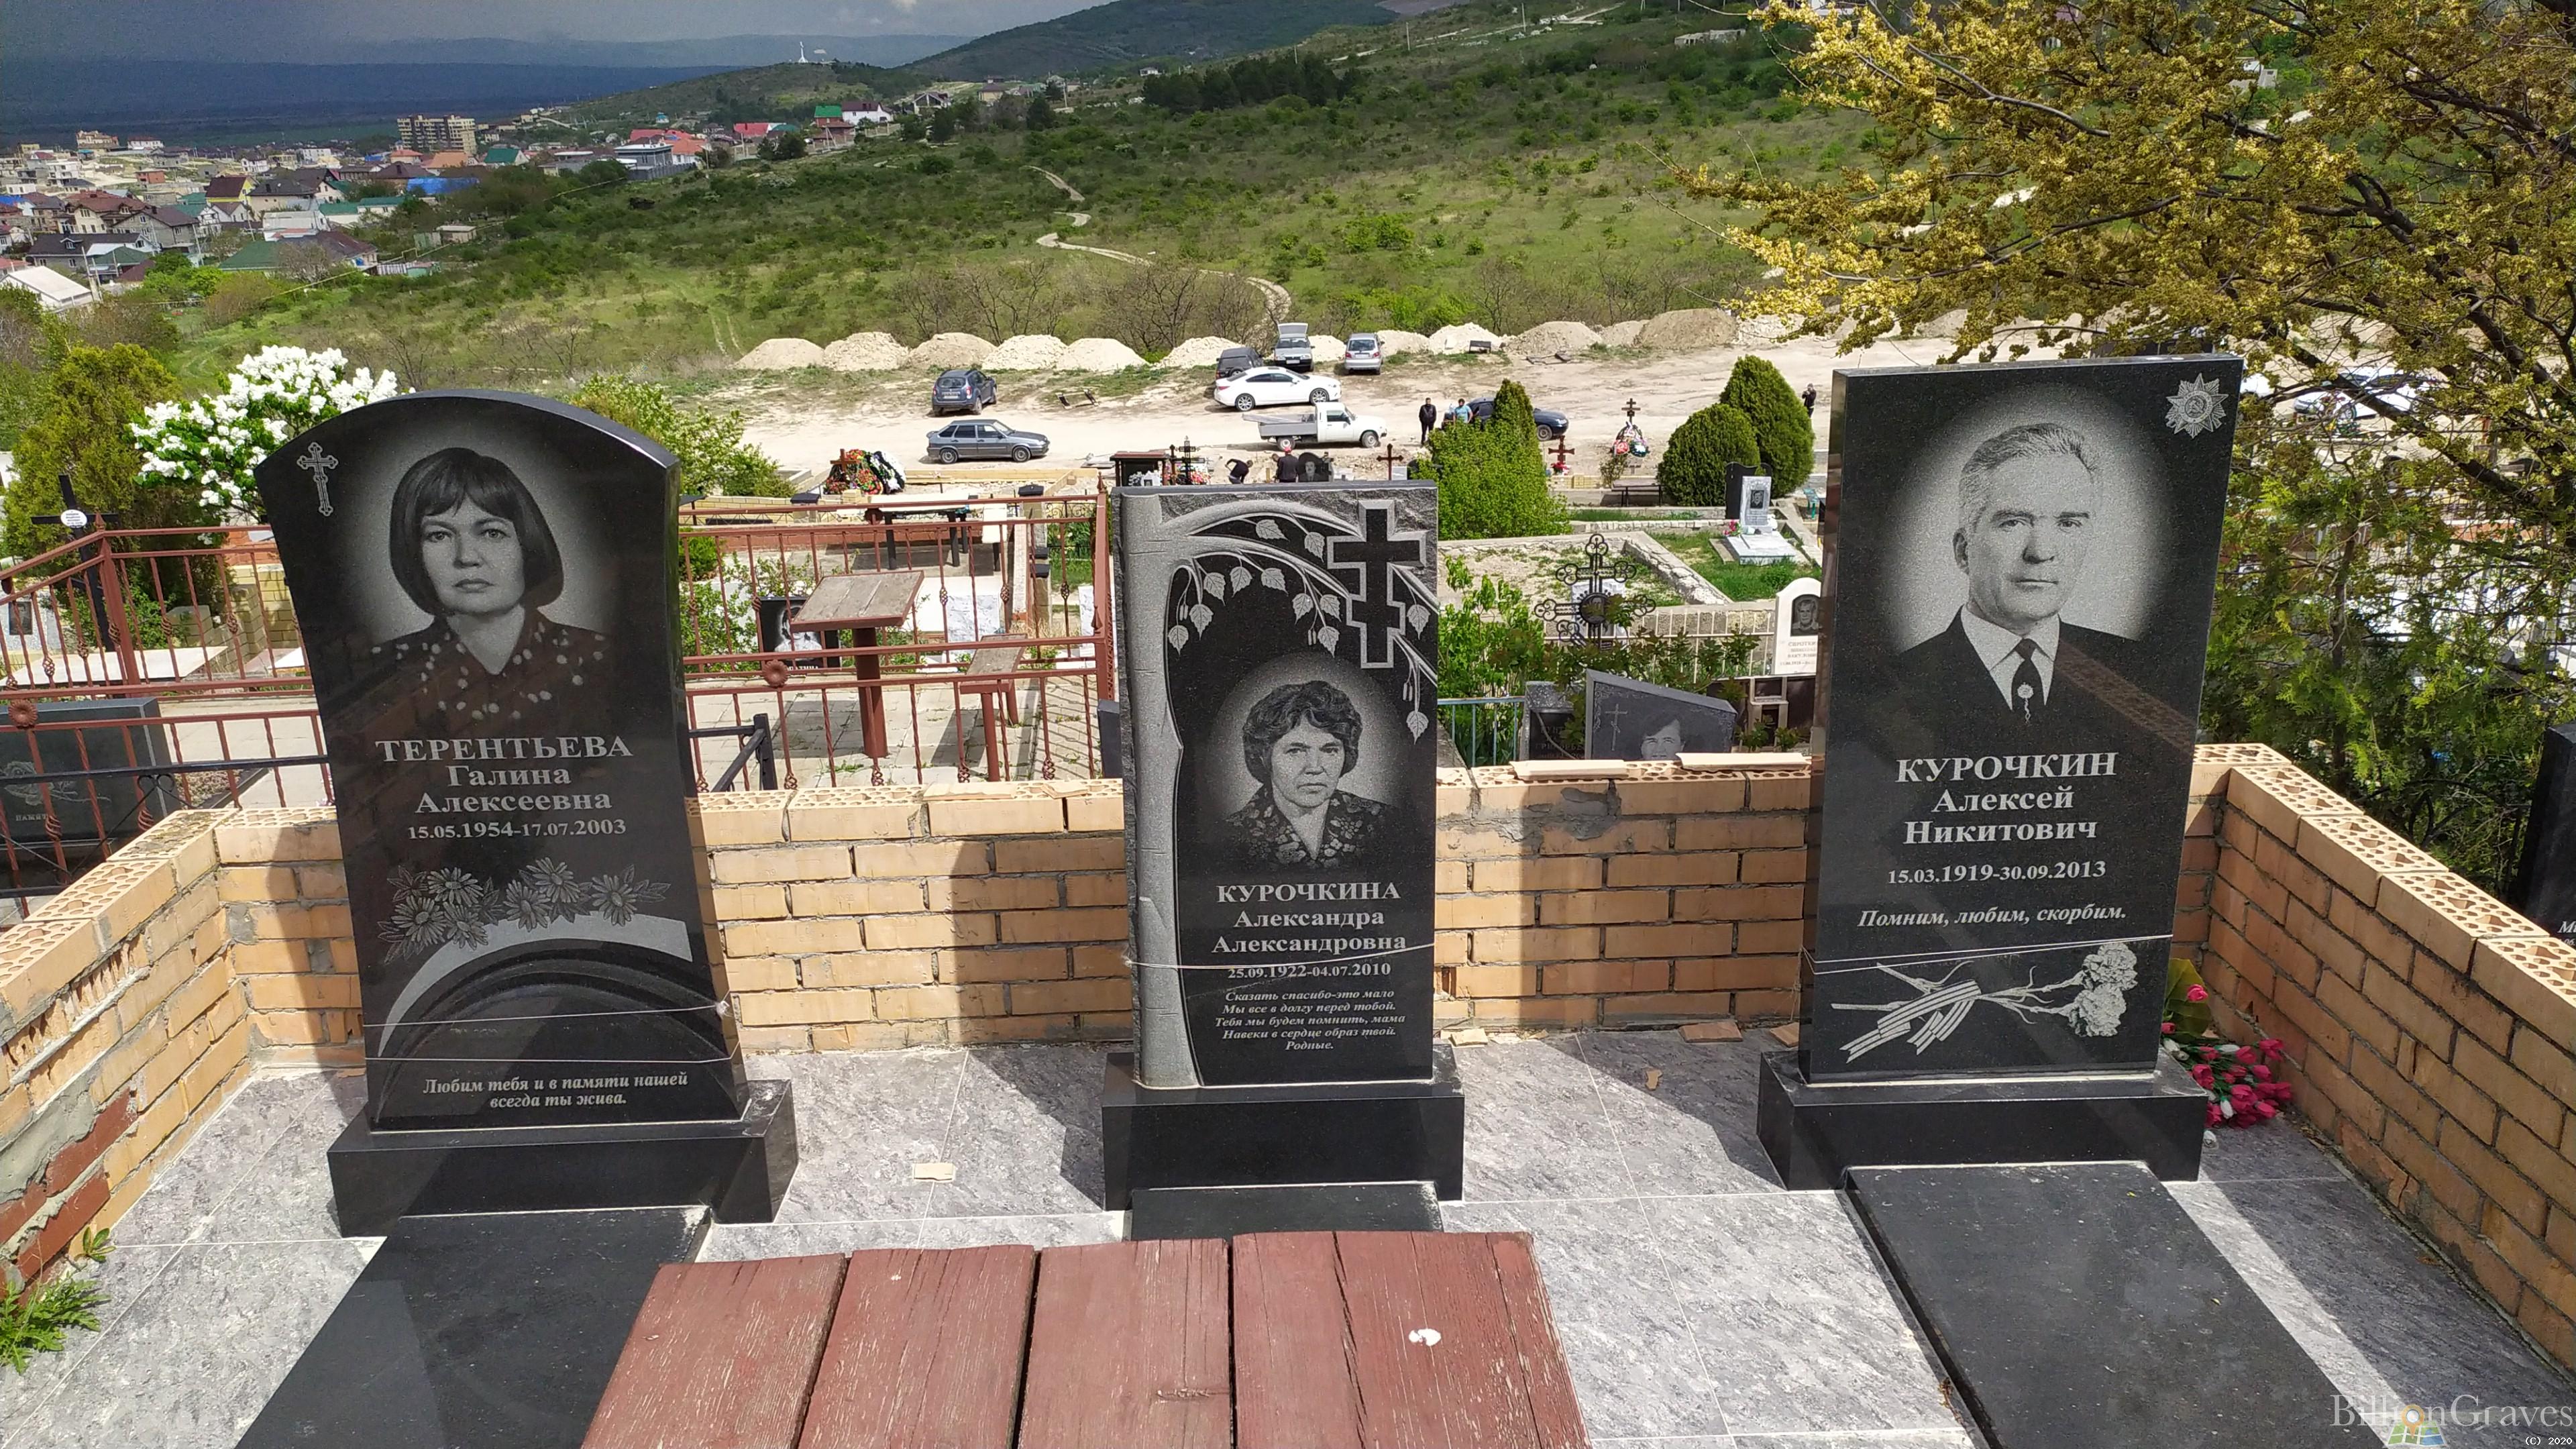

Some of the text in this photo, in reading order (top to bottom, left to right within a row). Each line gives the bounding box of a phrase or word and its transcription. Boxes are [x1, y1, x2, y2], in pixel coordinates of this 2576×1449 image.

[376, 737, 633, 761] ТЕРЕНТЬЕВА
[446, 765, 572, 787] Галина
[1895, 752, 2118, 782] КУРОЧКИН
[414, 792, 612, 814] Алексеевна
[1931, 785, 2074, 813] Алексей
[408, 820, 627, 839] 15.05.1954-17.07.2003
[1903, 821, 2098, 845] Никитович
[1888, 861, 2106, 883] 15.03.1919-30.09.2013
[1216, 882, 1401, 902] КУРОЧКИНА
[1234, 911, 1385, 930] Александра
[1858, 903, 2127, 927] Помним, любим, скорбим.
[1212, 936, 1406, 955] Александровна
[1228, 963, 1391, 979] 25.09.1922-04.07.2010
[1226, 989, 1394, 1001] Сказать спасибо-это мало
[1222, 1006, 1244, 1014] Мы
[1248, 1006, 1267, 1014] все
[1281, 1004, 1313, 1014] долгу
[1316, 1003, 1350, 1013] перед
[1354, 1002, 1396, 1011] тобой.
[1216, 1017, 1242, 1027] Тебя
[1269, 1016, 1304, 1027] будем
[1309, 1016, 1368, 1026] помнить,
[1371, 1014, 1405, 1023] мама
[1222, 1027, 1396, 1040] Навеки в сердце образ твой.
[1285, 1040, 1334, 1051] Родные.
[423, 1073, 688, 1093] Любим тебя и в памяти нашей
[490, 1093, 627, 1108] всегда ты жива.
